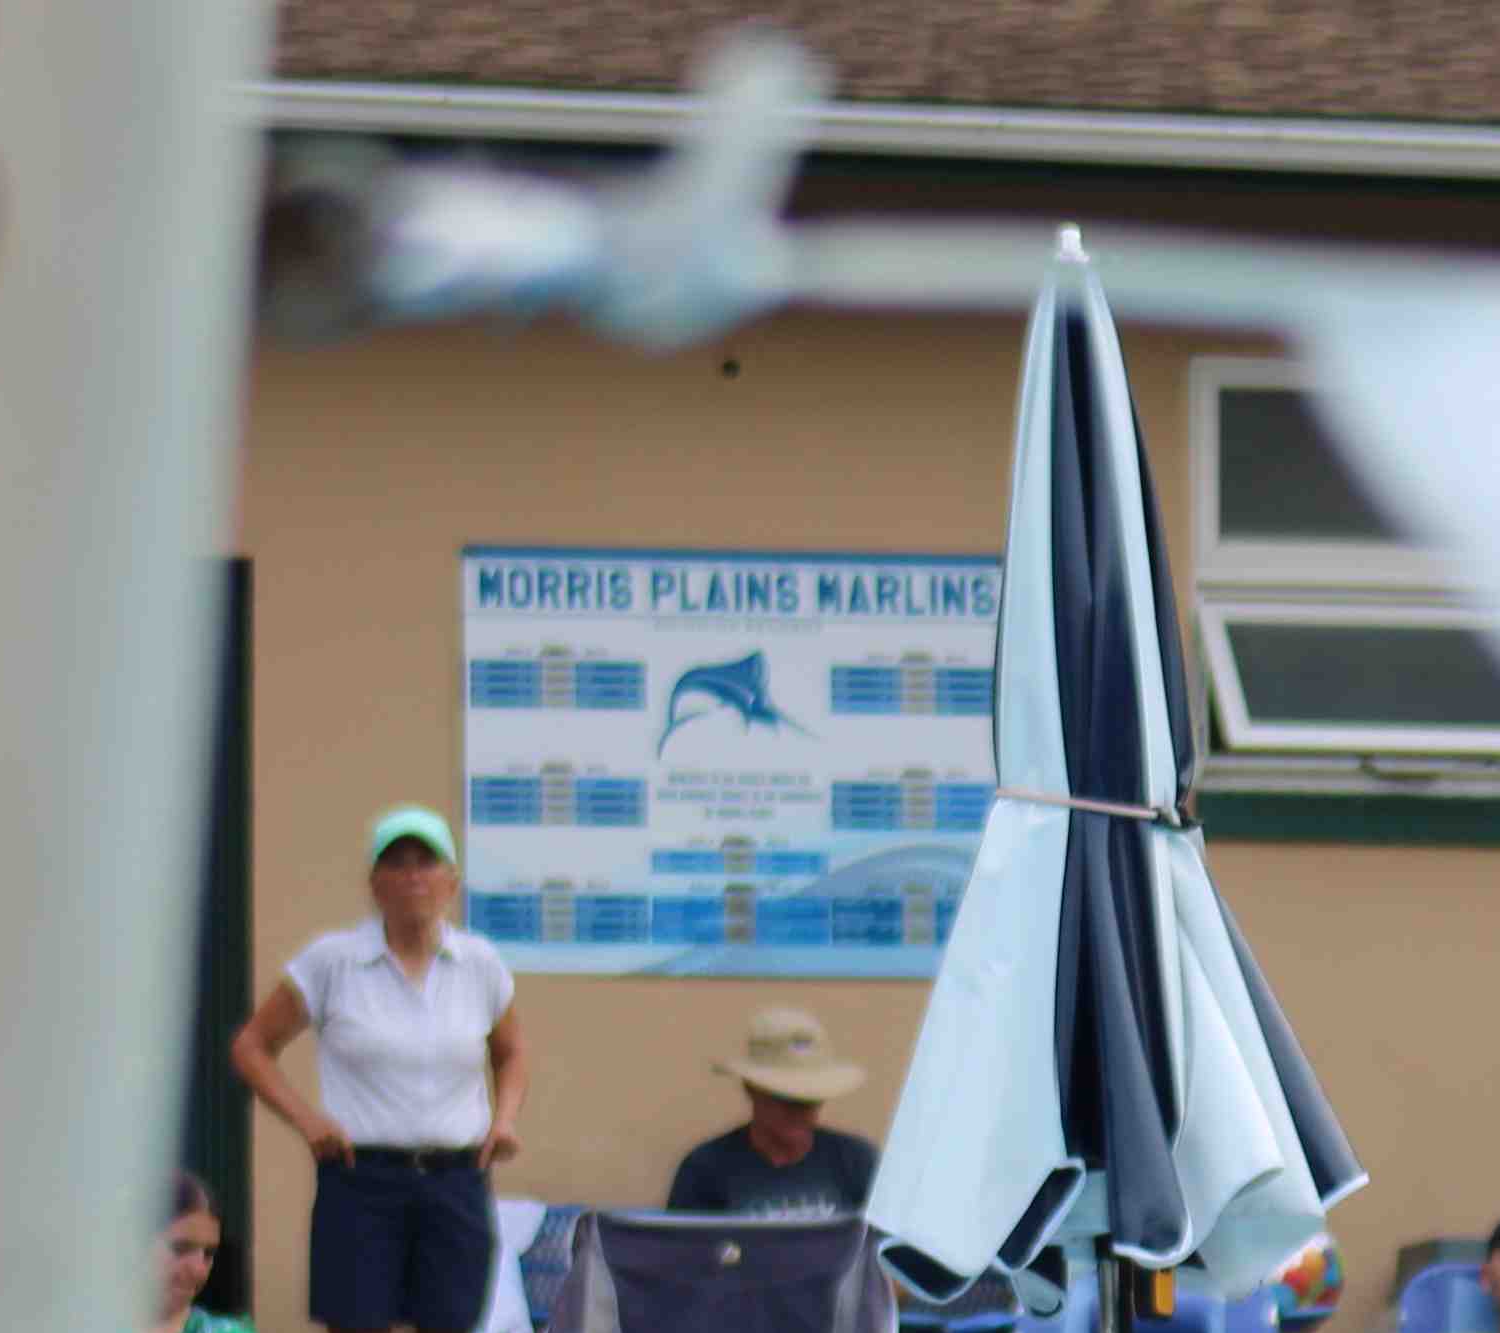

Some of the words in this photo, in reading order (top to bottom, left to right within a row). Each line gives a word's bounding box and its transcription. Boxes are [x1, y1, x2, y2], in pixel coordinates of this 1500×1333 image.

[478, 567, 633, 610] MORRIS
[650, 568, 799, 613] PLAINS
[818, 572, 997, 616] MARLINS
